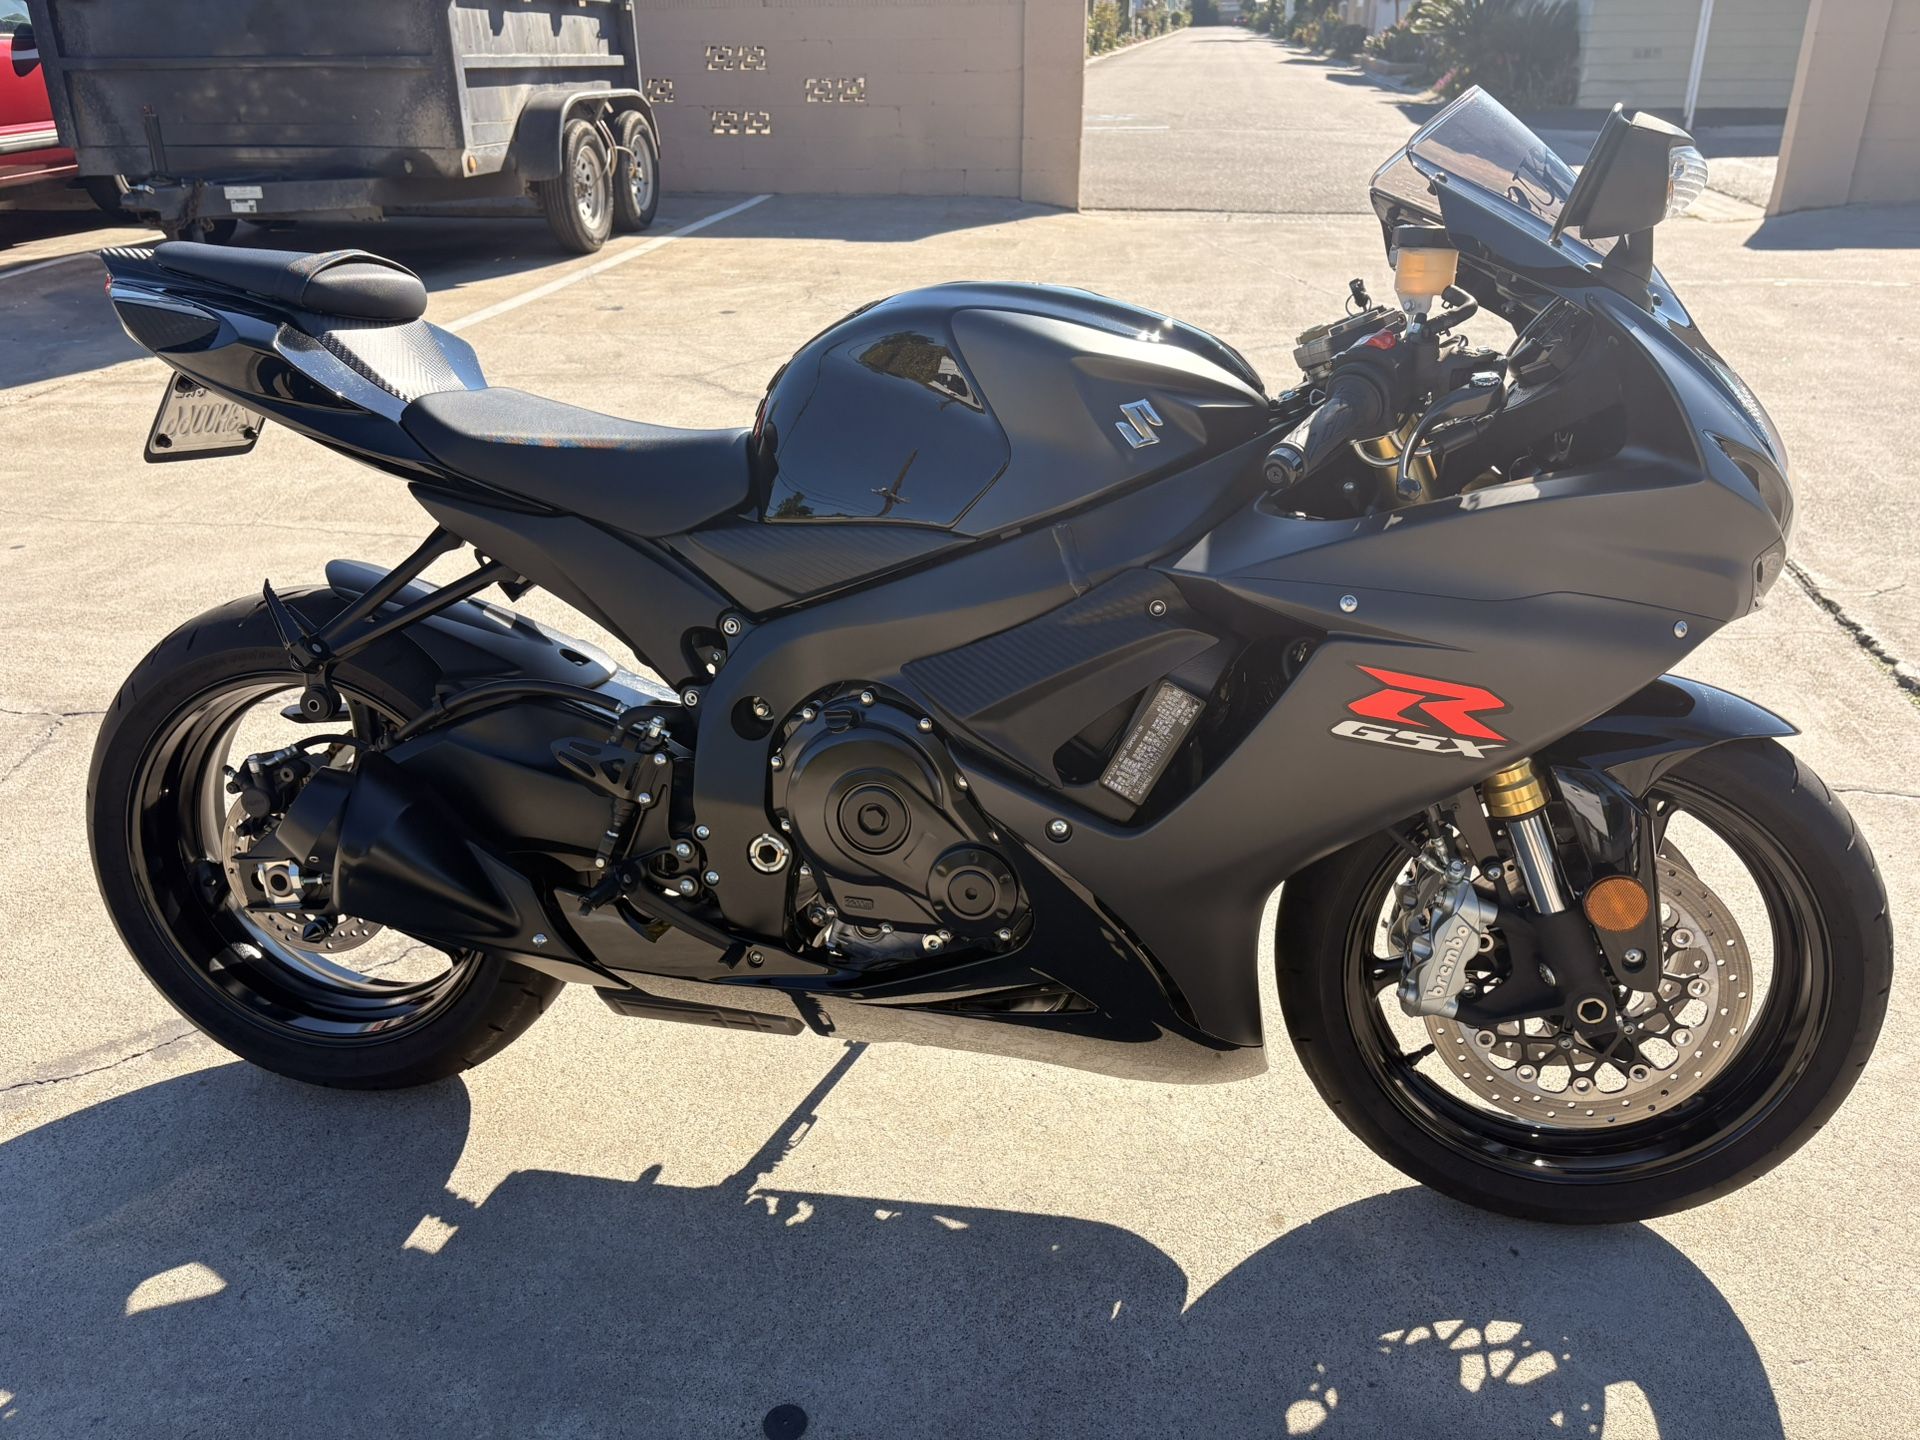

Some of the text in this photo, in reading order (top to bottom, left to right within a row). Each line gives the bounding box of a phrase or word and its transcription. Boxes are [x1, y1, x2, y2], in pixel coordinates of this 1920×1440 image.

[1347, 664, 1508, 742] R
[1330, 720, 1506, 759] GSX
[1425, 925, 1470, 997] brembo
